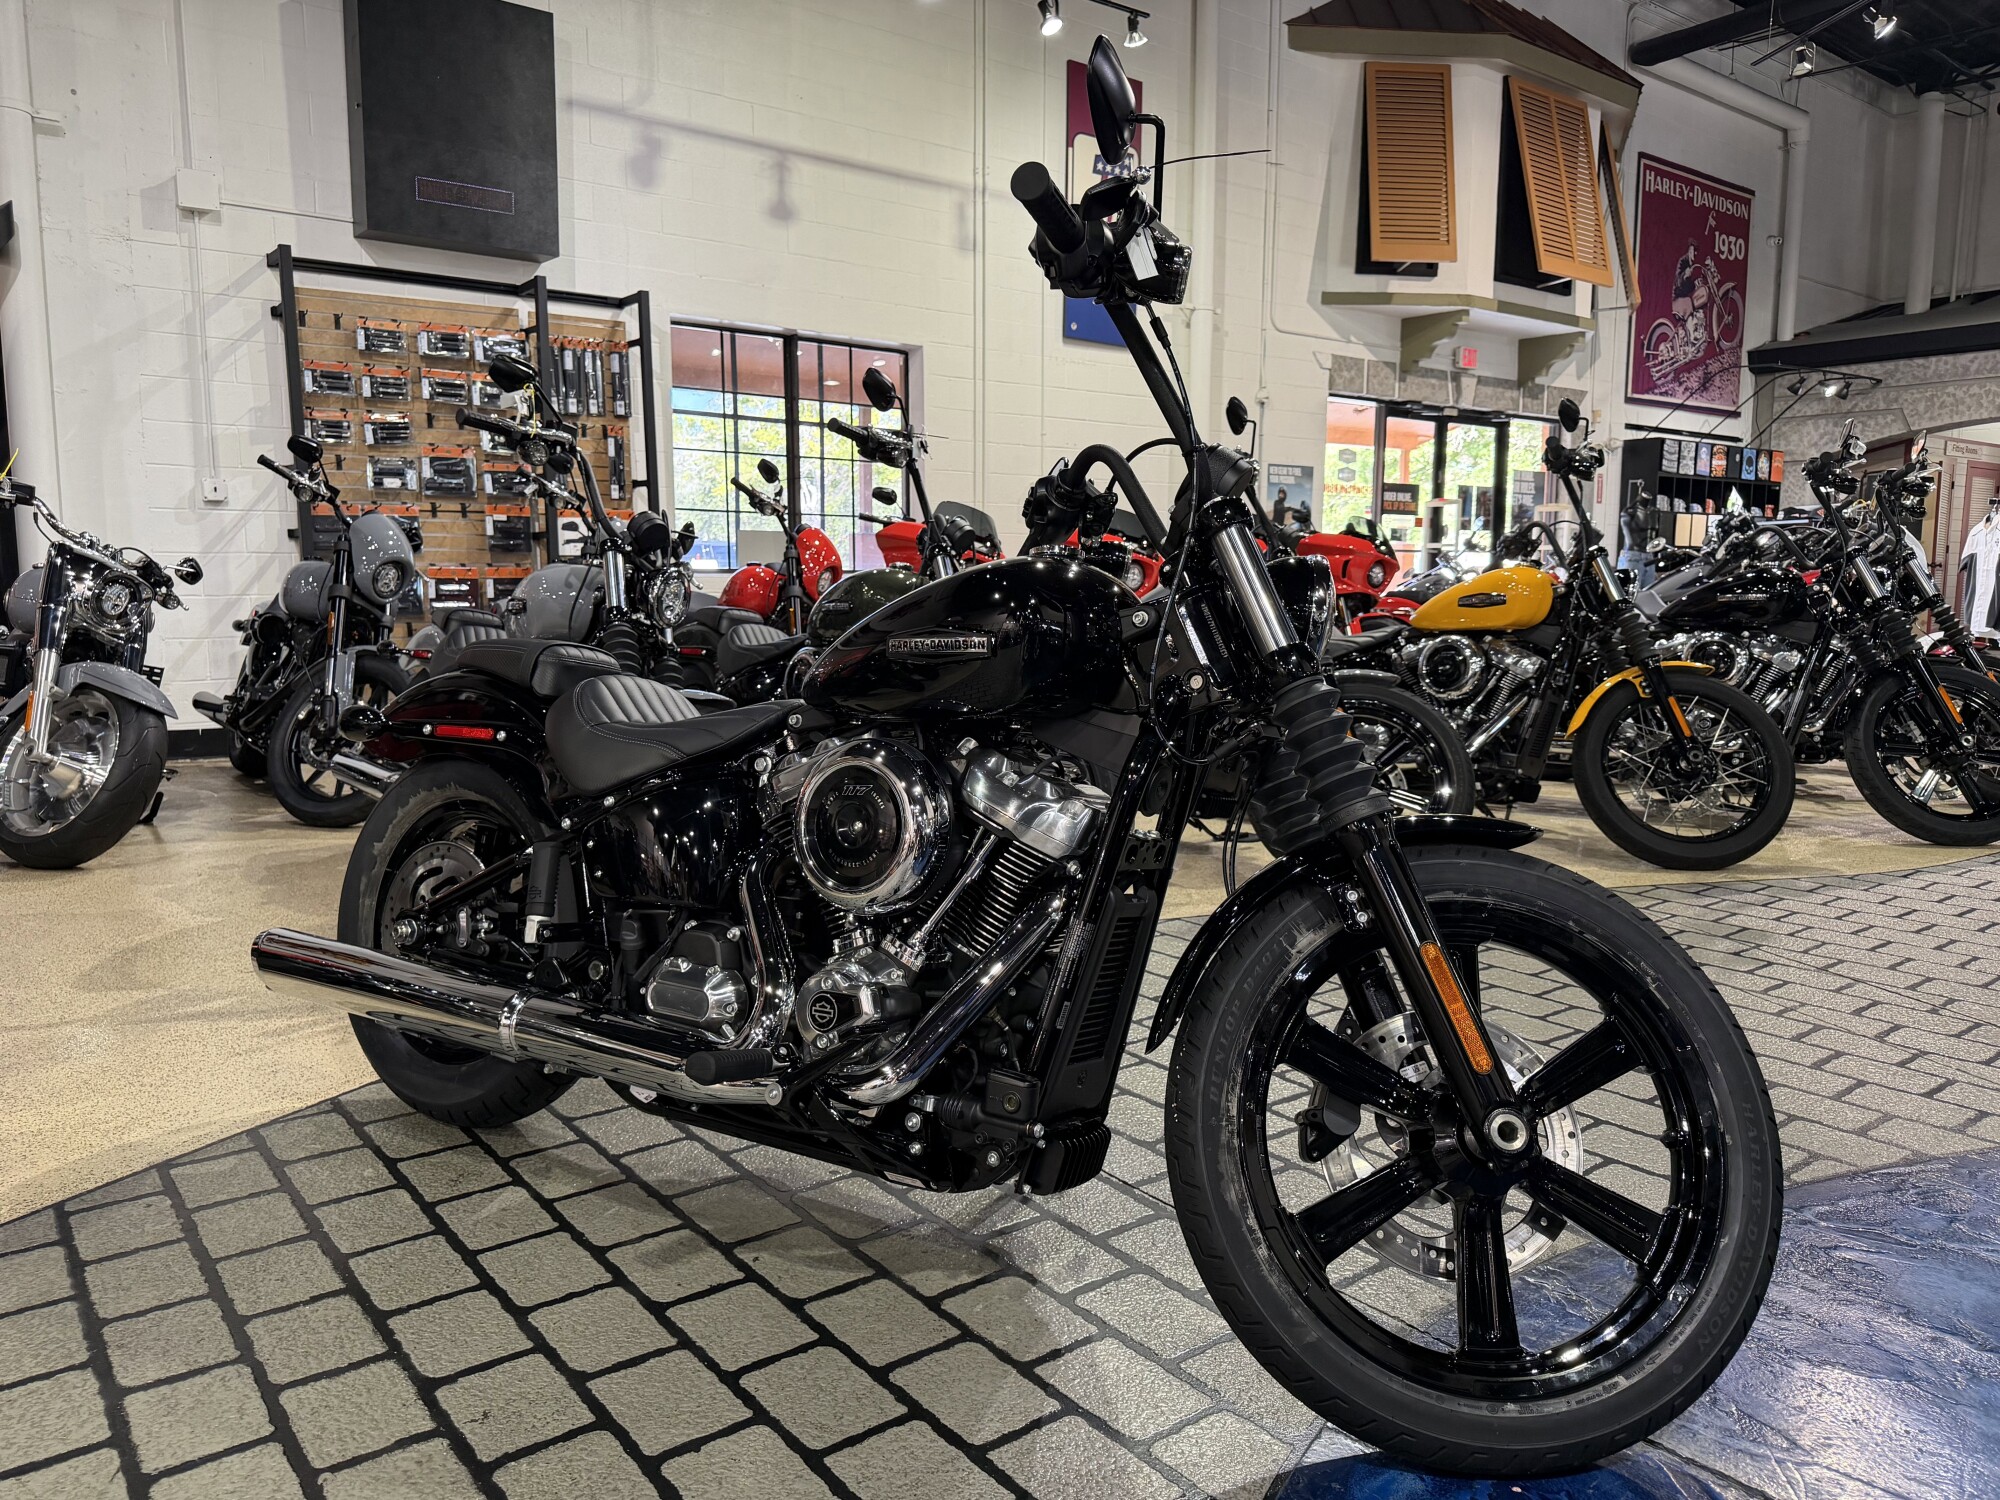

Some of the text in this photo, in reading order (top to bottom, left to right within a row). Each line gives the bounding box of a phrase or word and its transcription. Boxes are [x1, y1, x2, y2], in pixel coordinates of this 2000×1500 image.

[1645, 169, 1749, 220] HARLEY-DAVIDSON
[1714, 231, 1745, 260] 1930
[1462, 348, 1478, 368] EXIT
[1952, 443, 1978, 455] Fitting Rooms
[890, 639, 986, 652] HARLEY-DAVIDSON
[841, 784, 874, 796] 117
[1209, 999, 1241, 1103] DUNLOP
[1697, 1102, 1764, 1353] HARLEY-DAVIDSON
